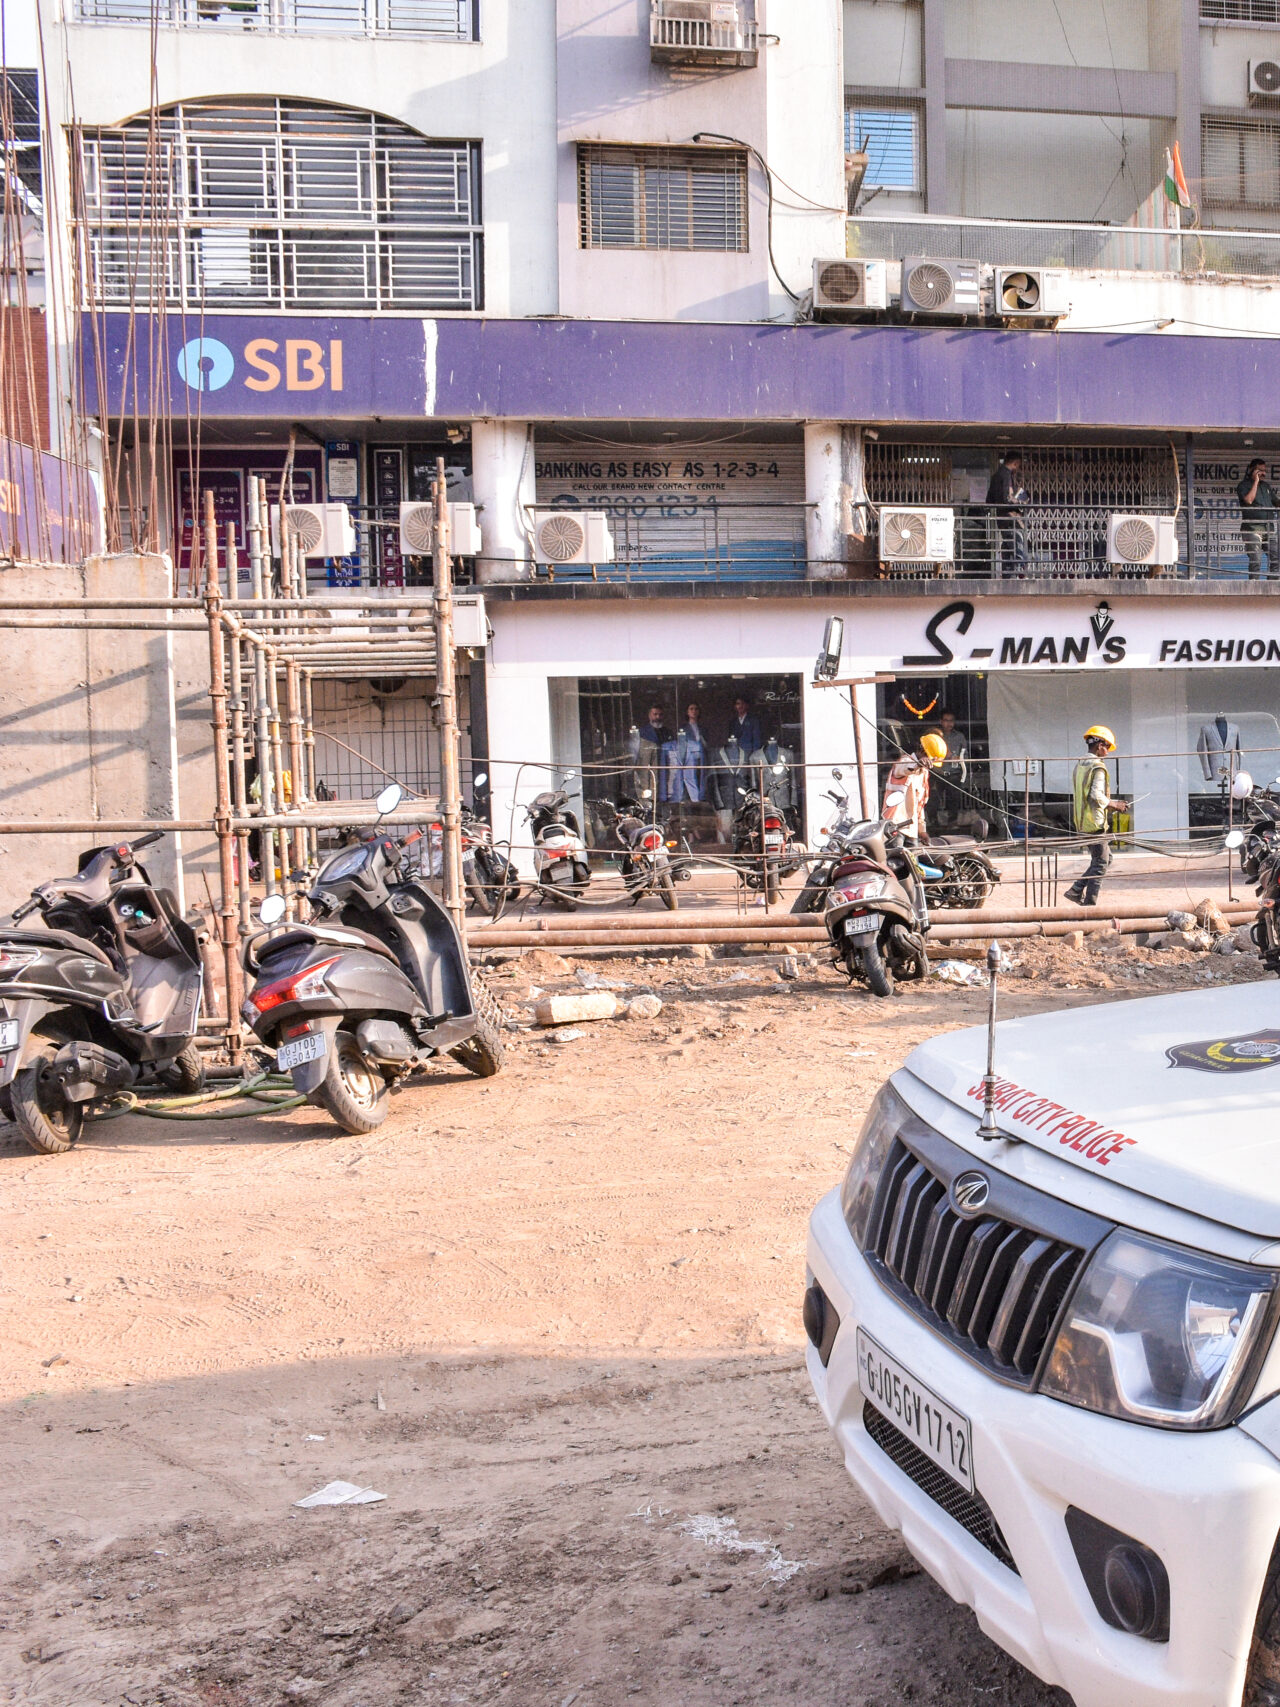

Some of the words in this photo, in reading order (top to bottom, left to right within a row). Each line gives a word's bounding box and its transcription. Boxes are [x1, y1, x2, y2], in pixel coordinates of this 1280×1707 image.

[243, 338, 343, 391] SBI
[534, 461, 603, 478] BANKING
[607, 461, 628, 478] AS
[632, 461, 673, 478] EASY
[682, 461, 705, 478] AS
[713, 461, 780, 478] 1-2-3-4
[1177, 463, 1240, 481] BNKING
[657, 482, 693, 490] CONTACT
[1012, 1097, 1075, 1131] CITY
[1046, 1114, 1138, 1166] POLICE
